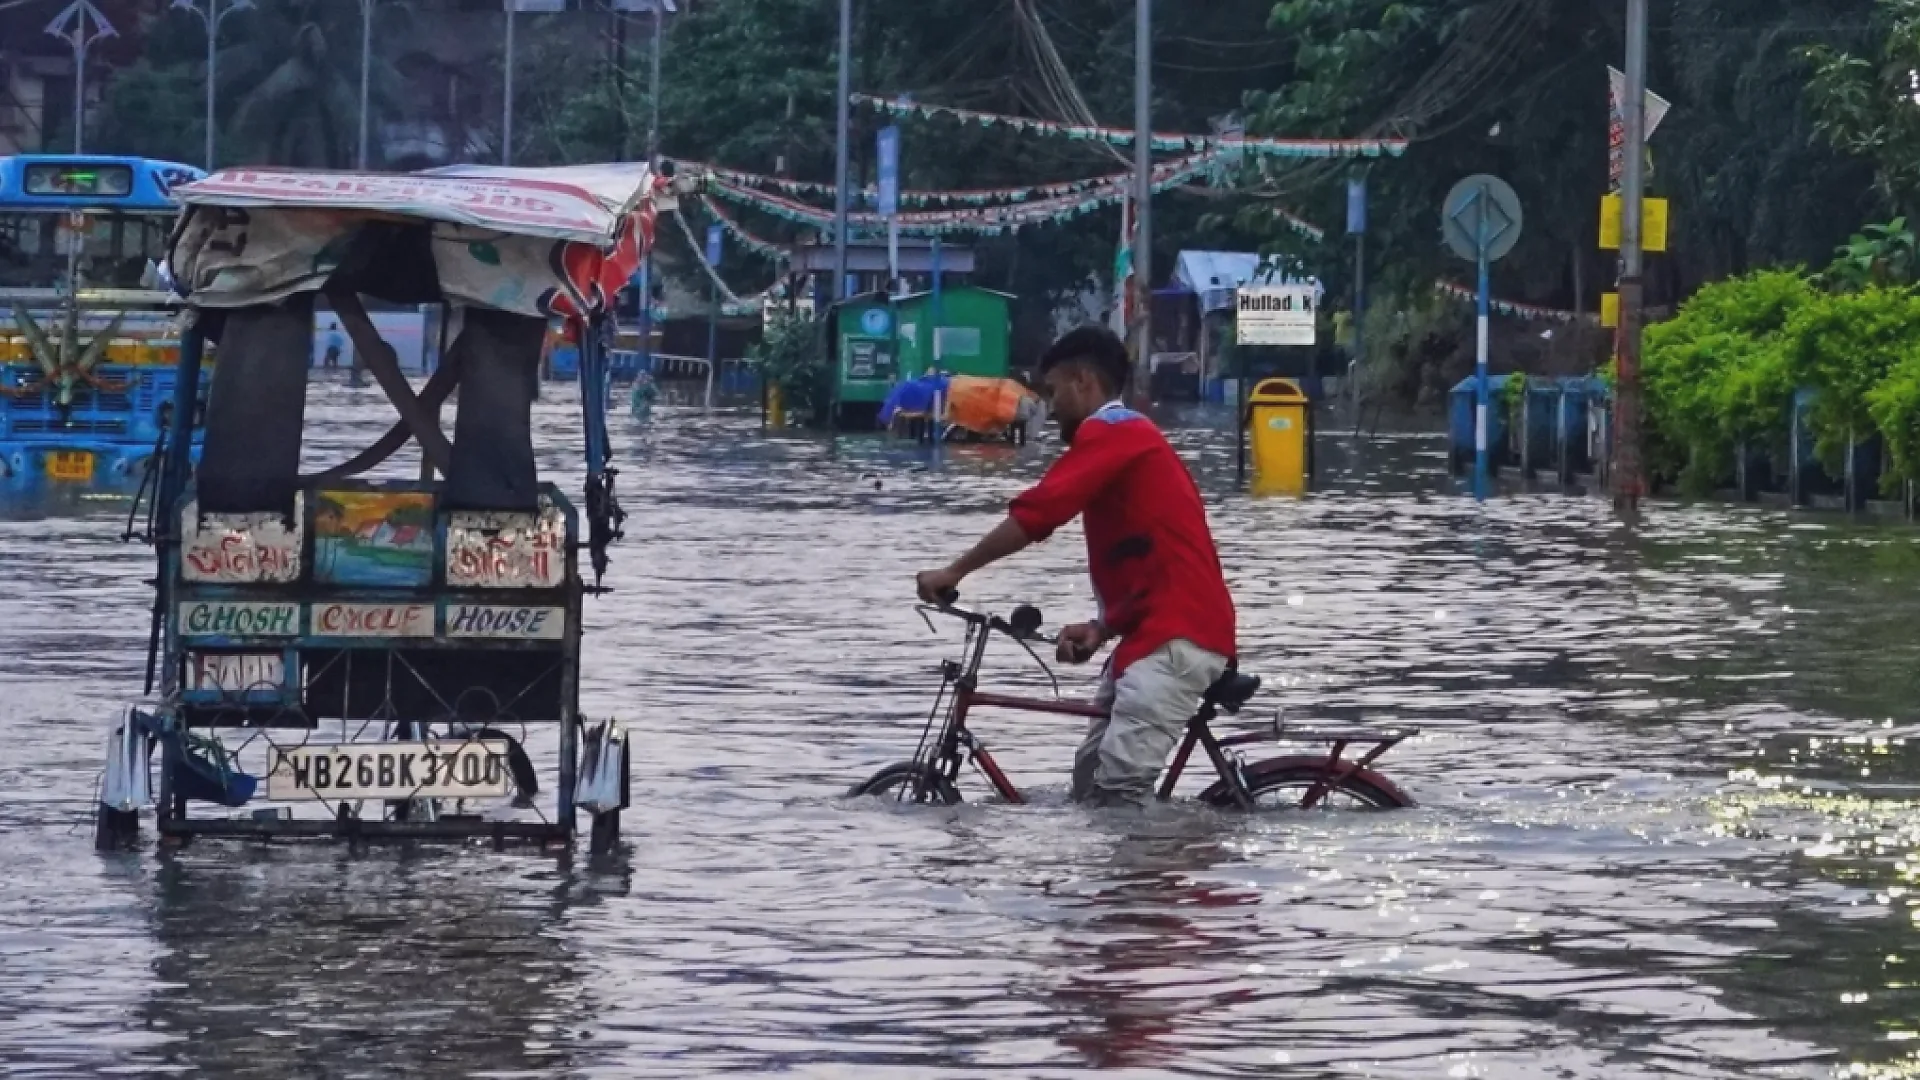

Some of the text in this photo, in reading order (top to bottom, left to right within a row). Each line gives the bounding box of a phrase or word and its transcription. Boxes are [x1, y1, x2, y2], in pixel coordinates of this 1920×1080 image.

[1240, 294, 1312, 312] Hulladk
[188, 604, 293, 632] GHOSH
[452, 606, 551, 633] HOUSE
[293, 752, 502, 789] WB26BK3700
